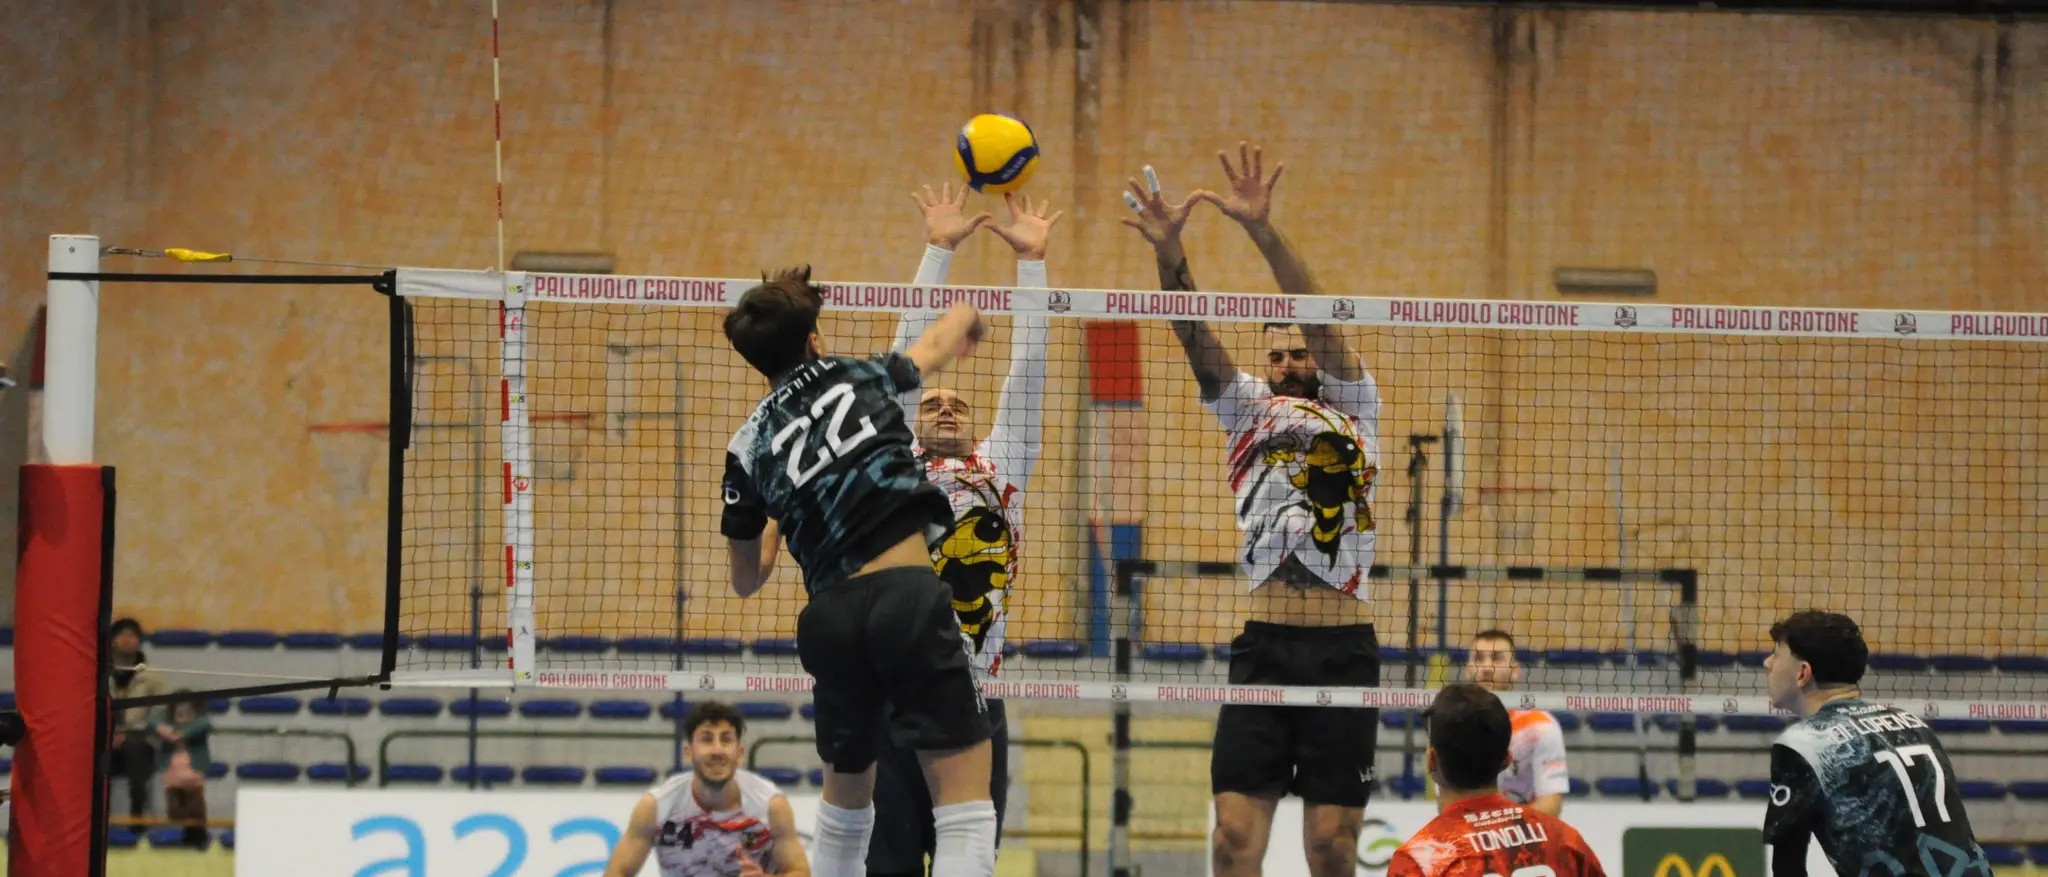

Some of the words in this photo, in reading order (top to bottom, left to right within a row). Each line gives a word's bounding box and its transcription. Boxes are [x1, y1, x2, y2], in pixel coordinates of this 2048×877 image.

[534, 276, 637, 299] PALLAVOLO
[643, 279, 726, 302] CROTONE
[929, 288, 1011, 312] CROTONE
[1105, 292, 1208, 317] PALLAVOLO
[1214, 295, 1297, 319] CROTONE
[1389, 300, 1491, 324] PALLAVOLO
[1497, 303, 1579, 327] CROTONE
[1671, 307, 1772, 331] PALLAVOLO
[1778, 310, 1859, 333] CROTONE
[1951, 314, 2048, 336] PALLAVOLO
[771, 382, 878, 489] 22
[538, 673, 609, 689] PALLAVOLO
[612, 674, 668, 690] CROTONE
[981, 681, 1021, 699] AVOLO
[1025, 683, 1080, 700] CROTONE
[1157, 686, 1226, 702] PALLAVOLO
[1229, 688, 1285, 704] CROTONE
[1362, 691, 1431, 708] PALLAVOLO
[1565, 696, 1635, 712] PALLAVOLO
[1637, 697, 1693, 713] CROTONE
[1969, 704, 2037, 719] PALLAVOLO
[1873, 744, 1951, 828] 17
[1463, 822, 1548, 852] TONOLLI
